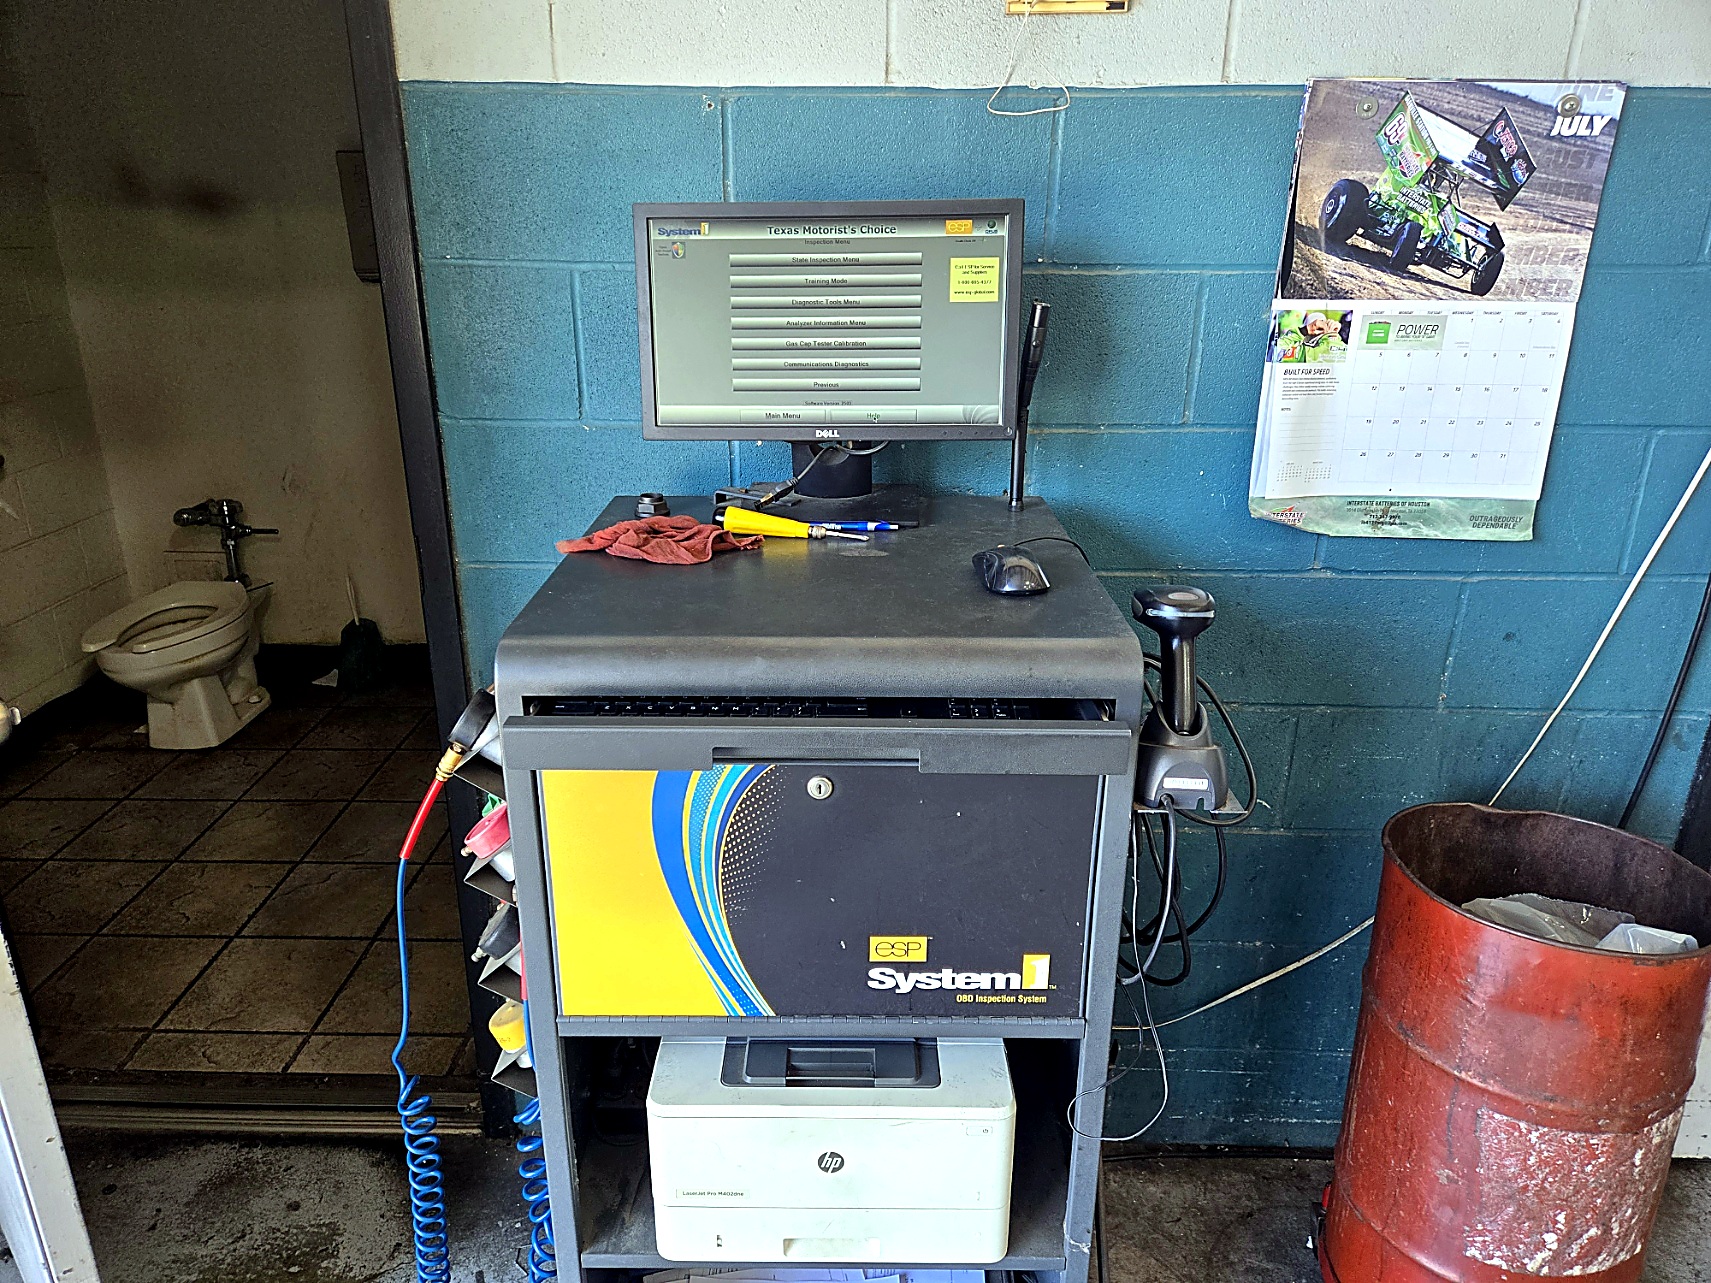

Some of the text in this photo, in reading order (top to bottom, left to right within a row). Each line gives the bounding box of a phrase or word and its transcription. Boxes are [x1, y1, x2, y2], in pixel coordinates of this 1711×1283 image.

[1550, 116, 1612, 136] JULY
[1397, 194, 1426, 213] BATTERIES
[1400, 187, 1432, 207] INTERSTATE
[767, 225, 897, 235] Texas Motorist's Choice
[1397, 324, 1440, 335] POWER
[816, 429, 840, 438] DELL
[1469, 515, 1524, 523] OUTRAGEOUSLY
[867, 967, 1022, 994] System
[956, 994, 1047, 1004] OBD Inspection System
[820, 1152, 842, 1174] hp
